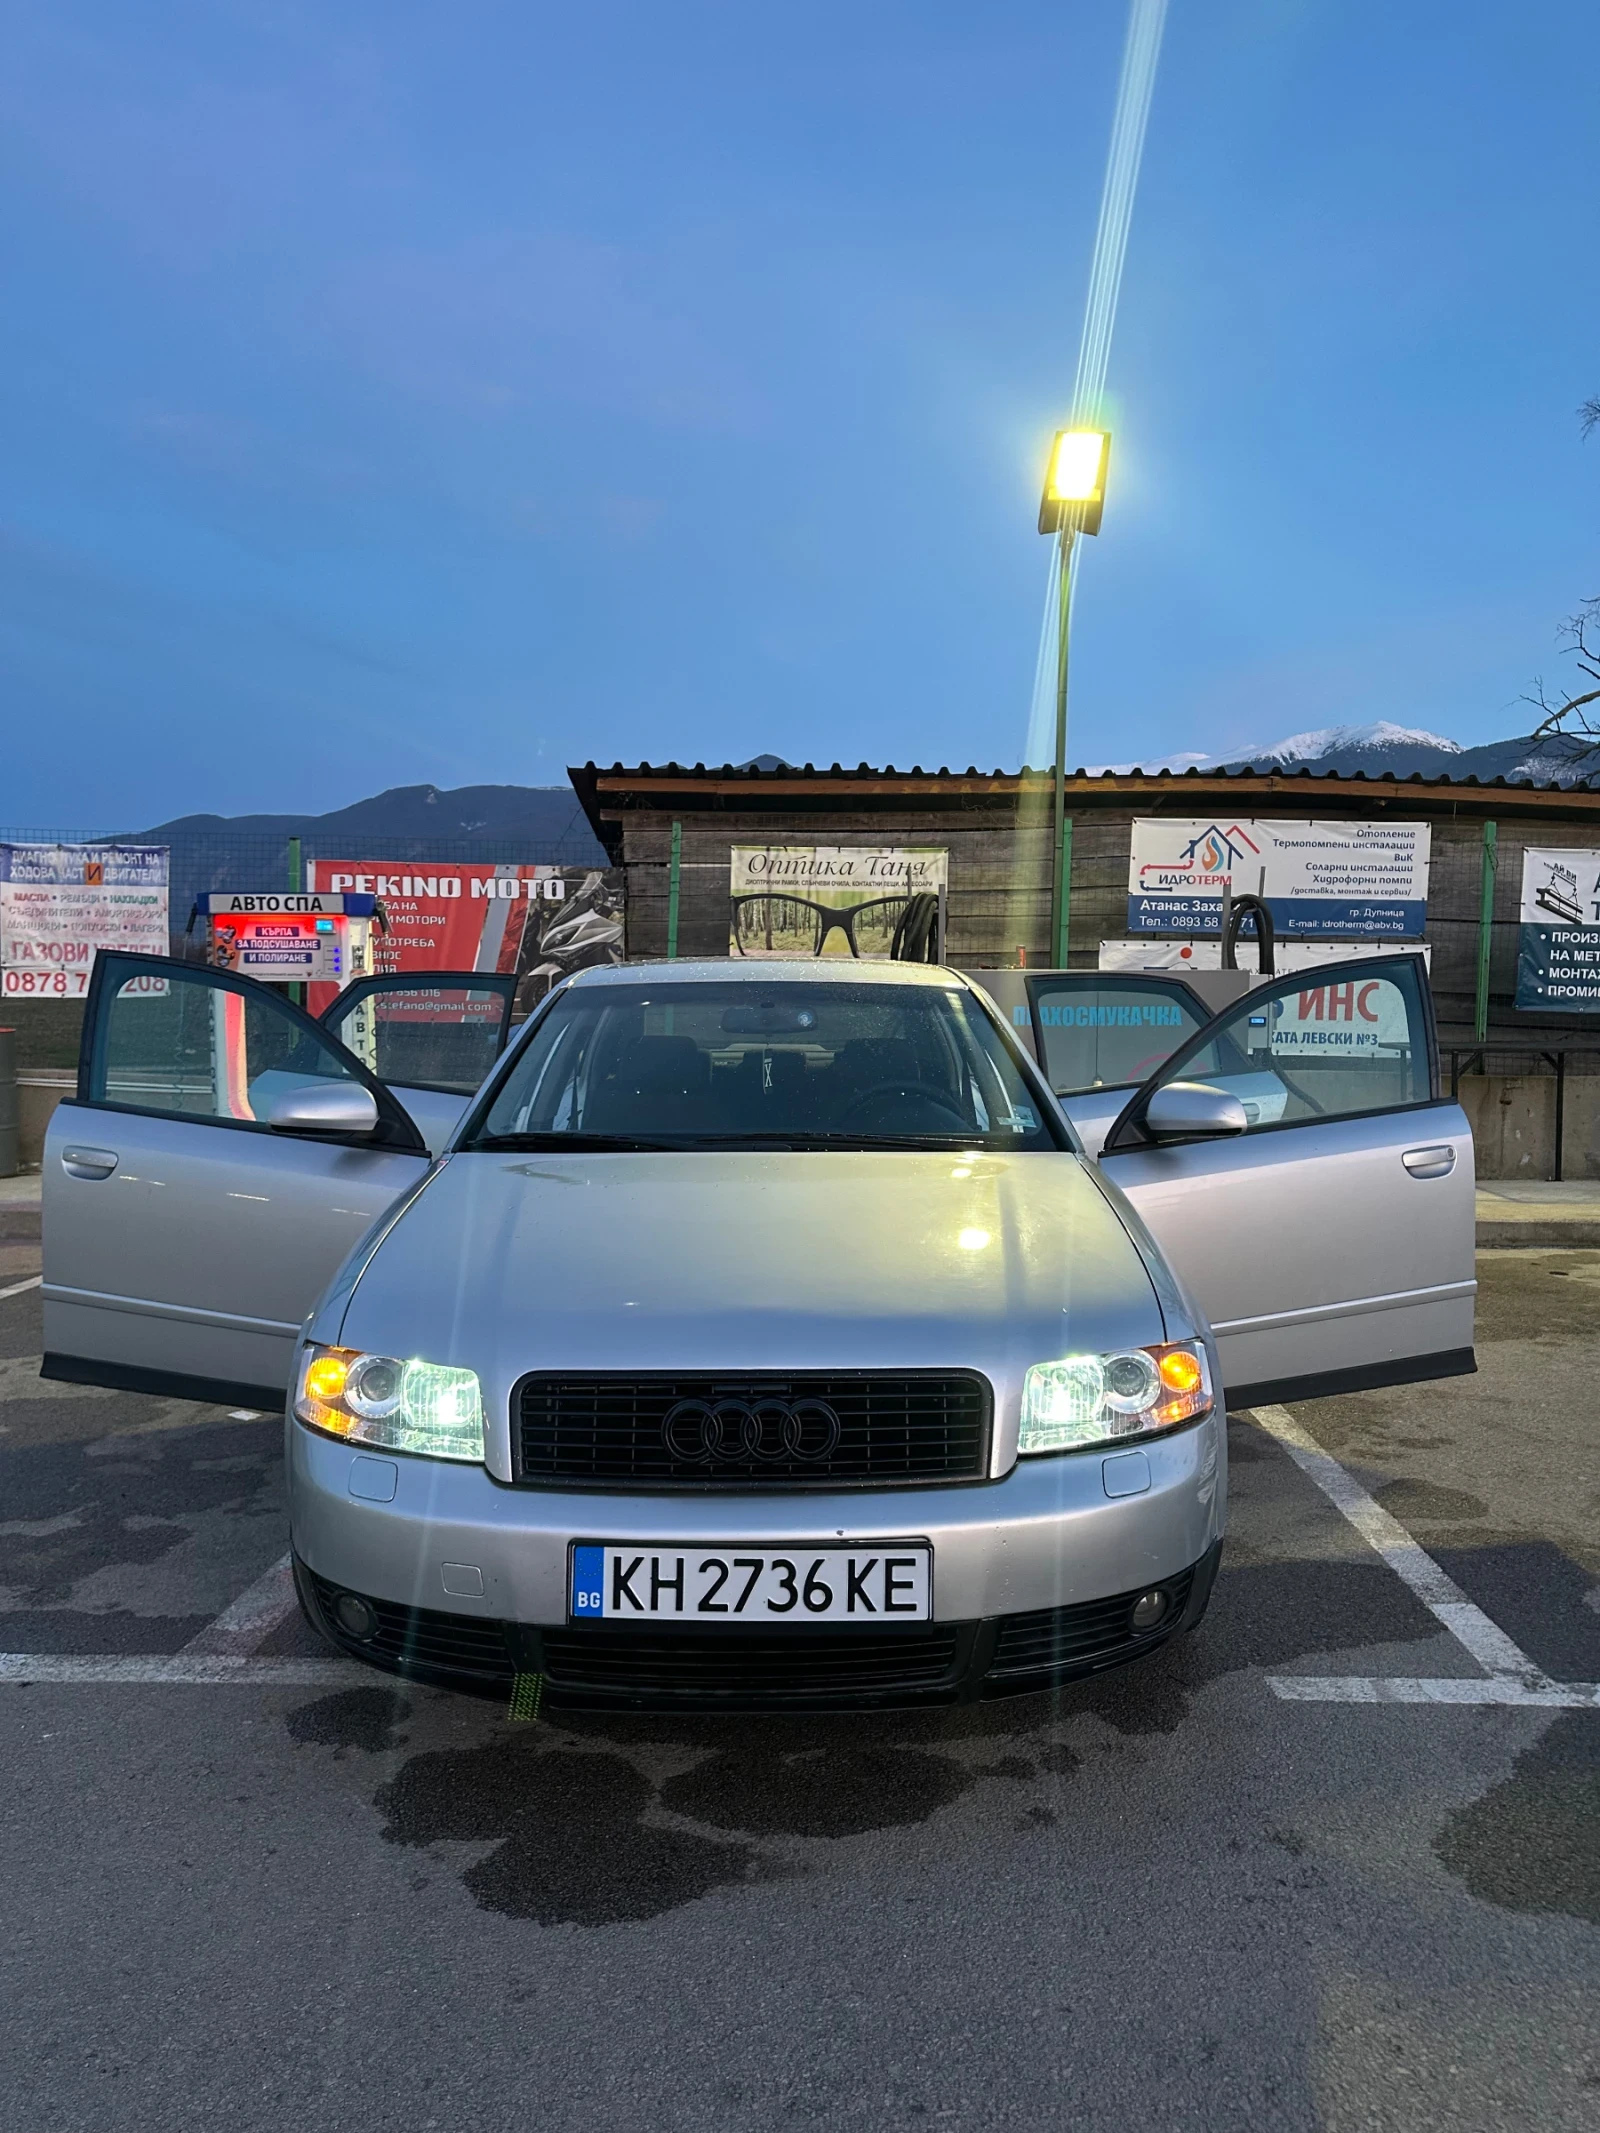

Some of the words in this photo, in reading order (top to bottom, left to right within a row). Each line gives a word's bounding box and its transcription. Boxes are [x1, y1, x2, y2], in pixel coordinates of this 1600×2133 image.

[1356, 829, 1416, 839] Отопление
[1273, 838, 1350, 849] Термопомпени
[1352, 840, 1415, 850] инсталации
[12, 850, 90, 864] ДИАГНОТИКА
[102, 852, 142, 864] РЕМОНТ
[145, 853, 160, 864] НА
[1394, 853, 1413, 862] ВиК
[748, 854, 855, 875] Оптика
[864, 856, 926, 876] Таня
[1305, 862, 1348, 873] Соларни
[1350, 863, 1413, 873] инсталации
[10, 866, 57, 879] ХОДОВА
[104, 868, 161, 881] ДВИГАТЕЛИ
[1158, 874, 1232, 886] ИДРОТЕРМ
[1313, 874, 1377, 885] Хидрофорни
[1379, 876, 1412, 885] помпи
[331, 874, 462, 898] PEKINO
[471, 878, 566, 900] MOTO
[230, 896, 280, 911] АВТО
[284, 896, 323, 911] СПА
[1140, 899, 1188, 911] Атанас
[1192, 900, 1224, 912] Заха
[1349, 909, 1362, 918] гр.
[1363, 908, 1405, 918] Дупница
[396, 915, 446, 925] МОТОРИ
[1139, 915, 1168, 928] Тел.:
[1171, 916, 1201, 928] 0893
[1203, 916, 1219, 928] 58
[1288, 919, 1320, 929] E-mail:
[1321, 919, 1405, 931] idrotherm@abv.bg
[261, 927, 293, 936] КЪРПА
[1551, 931, 1600, 944] ПРОИЗ
[236, 939, 249, 949] ЗА
[250, 939, 318, 950] ПОДСУШАВАНЕ
[11, 941, 89, 962] ГАЗОВИ
[248, 953, 257, 963] И
[258, 953, 307, 963] ПОЛИРАНЕ
[1550, 949, 1570, 961] НА
[1573, 950, 1600, 962] МЕТ
[5, 971, 67, 992] 0878
[1547, 985, 1600, 998] ПРОМИ
[1301, 1031, 1353, 1045] ЛЕВСКИ
[1356, 1033, 1379, 1046] №3
[697, 1558, 833, 1613] 2736
[578, 1591, 601, 1608] BG
